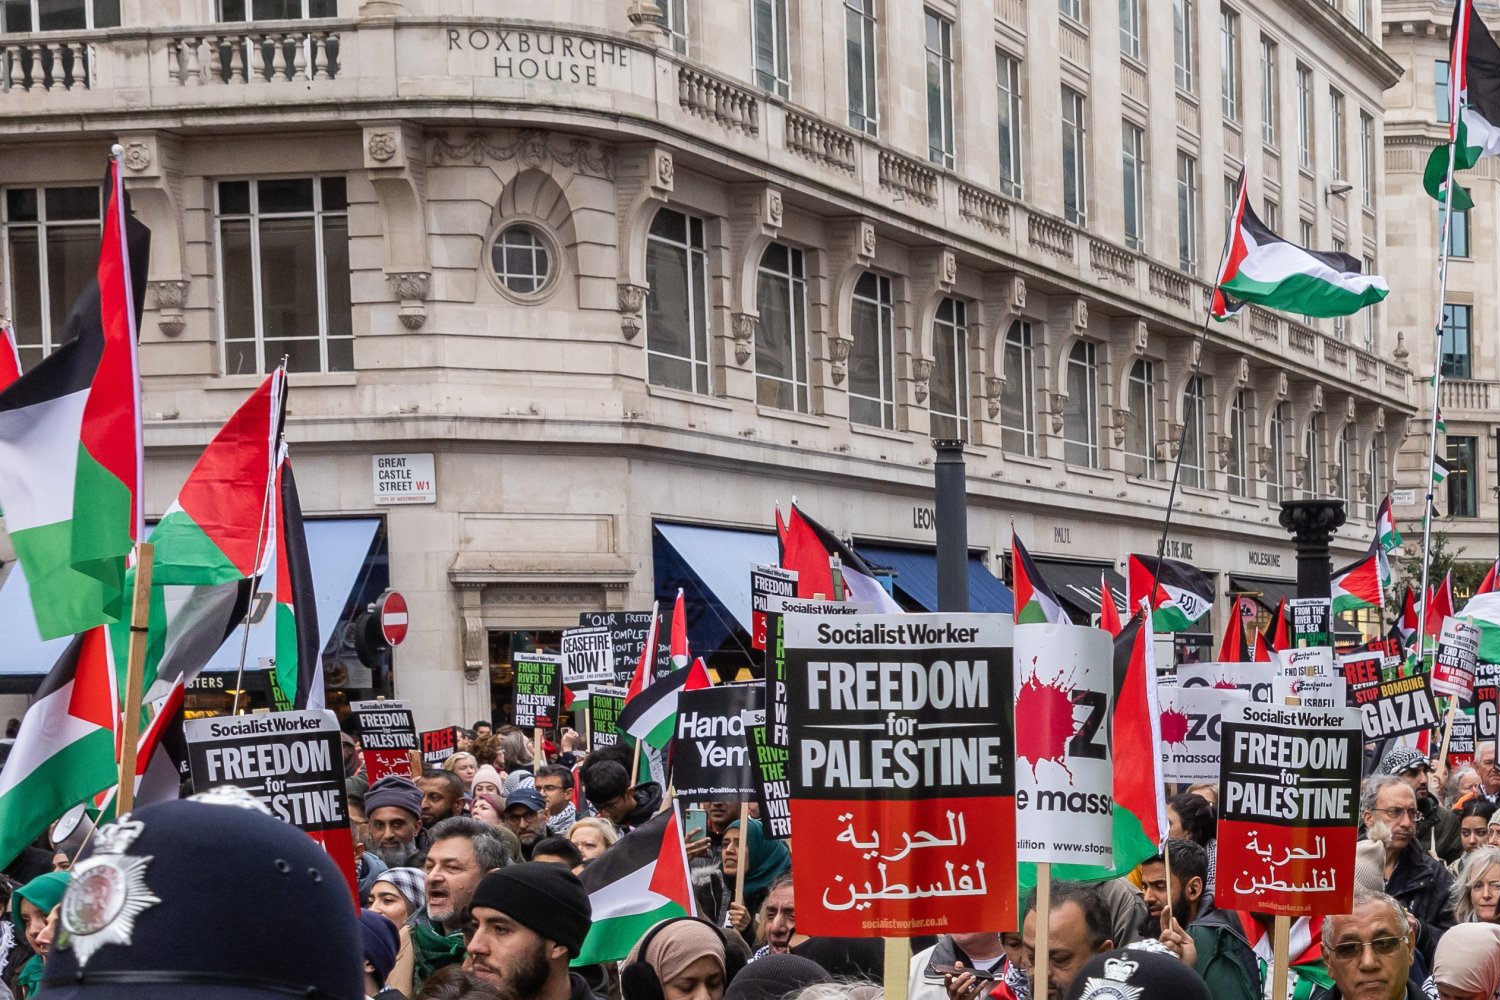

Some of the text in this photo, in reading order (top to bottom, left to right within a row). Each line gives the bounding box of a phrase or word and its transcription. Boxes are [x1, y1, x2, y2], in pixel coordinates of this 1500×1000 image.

[446, 28, 628, 68] ROXBURGHE
[493, 56, 597, 87] HOUSE
[378, 457, 407, 468] GREAT
[378, 469, 412, 480] CASTLE
[379, 481, 430, 492] STREET W1
[1053, 526, 1072, 544] PAUL
[1248, 551, 1281, 568] MOLESKINE
[754, 575, 793, 597] FREEDOM
[781, 601, 822, 614] Socialist
[822, 605, 858, 614] Worker
[1312, 606, 1325, 615] THE
[1295, 624, 1320, 633] THE SEA
[1313, 615, 1322, 624] TO
[817, 622, 979, 645] Socialist Worker
[563, 634, 610, 654] CEASEFIRE
[518, 662, 556, 675] FROM THE
[517, 673, 540, 684] RIVER
[542, 674, 552, 685] TO
[807, 660, 989, 711] FREEDOM
[517, 683, 548, 695] THE SEA
[1355, 686, 1379, 703] STOP
[1380, 676, 1426, 698] BOMBING
[516, 693, 556, 707] PALESTINE
[592, 695, 613, 708] FROM
[516, 704, 547, 717] WILL BE
[593, 708, 613, 721] RIVER
[1243, 706, 1344, 728] Socialist Worker
[1361, 689, 1435, 738] GAZA
[211, 716, 322, 738] Socialist Worker
[359, 712, 410, 728] FREEDOM
[515, 714, 535, 726] FREE
[594, 720, 606, 732] THE
[886, 712, 917, 736] for
[361, 733, 416, 748] PALESTINE
[423, 727, 454, 752] FREE
[1233, 730, 1349, 770] FREEDOM
[206, 739, 332, 782] FREEDOM
[801, 737, 1002, 789] PALESTINE
[760, 763, 786, 781] THE
[1279, 768, 1300, 786] for
[265, 777, 286, 794] for
[697, 787, 709, 795] War
[1226, 780, 1352, 820] PALESTINE
[836, 810, 966, 862] الحرية
[1245, 830, 1326, 867] الحرية
[822, 859, 988, 911] لفلسطين
[1233, 864, 1336, 896] لفلسطين
[861, 915, 948, 930] socialistworker.co.uk
